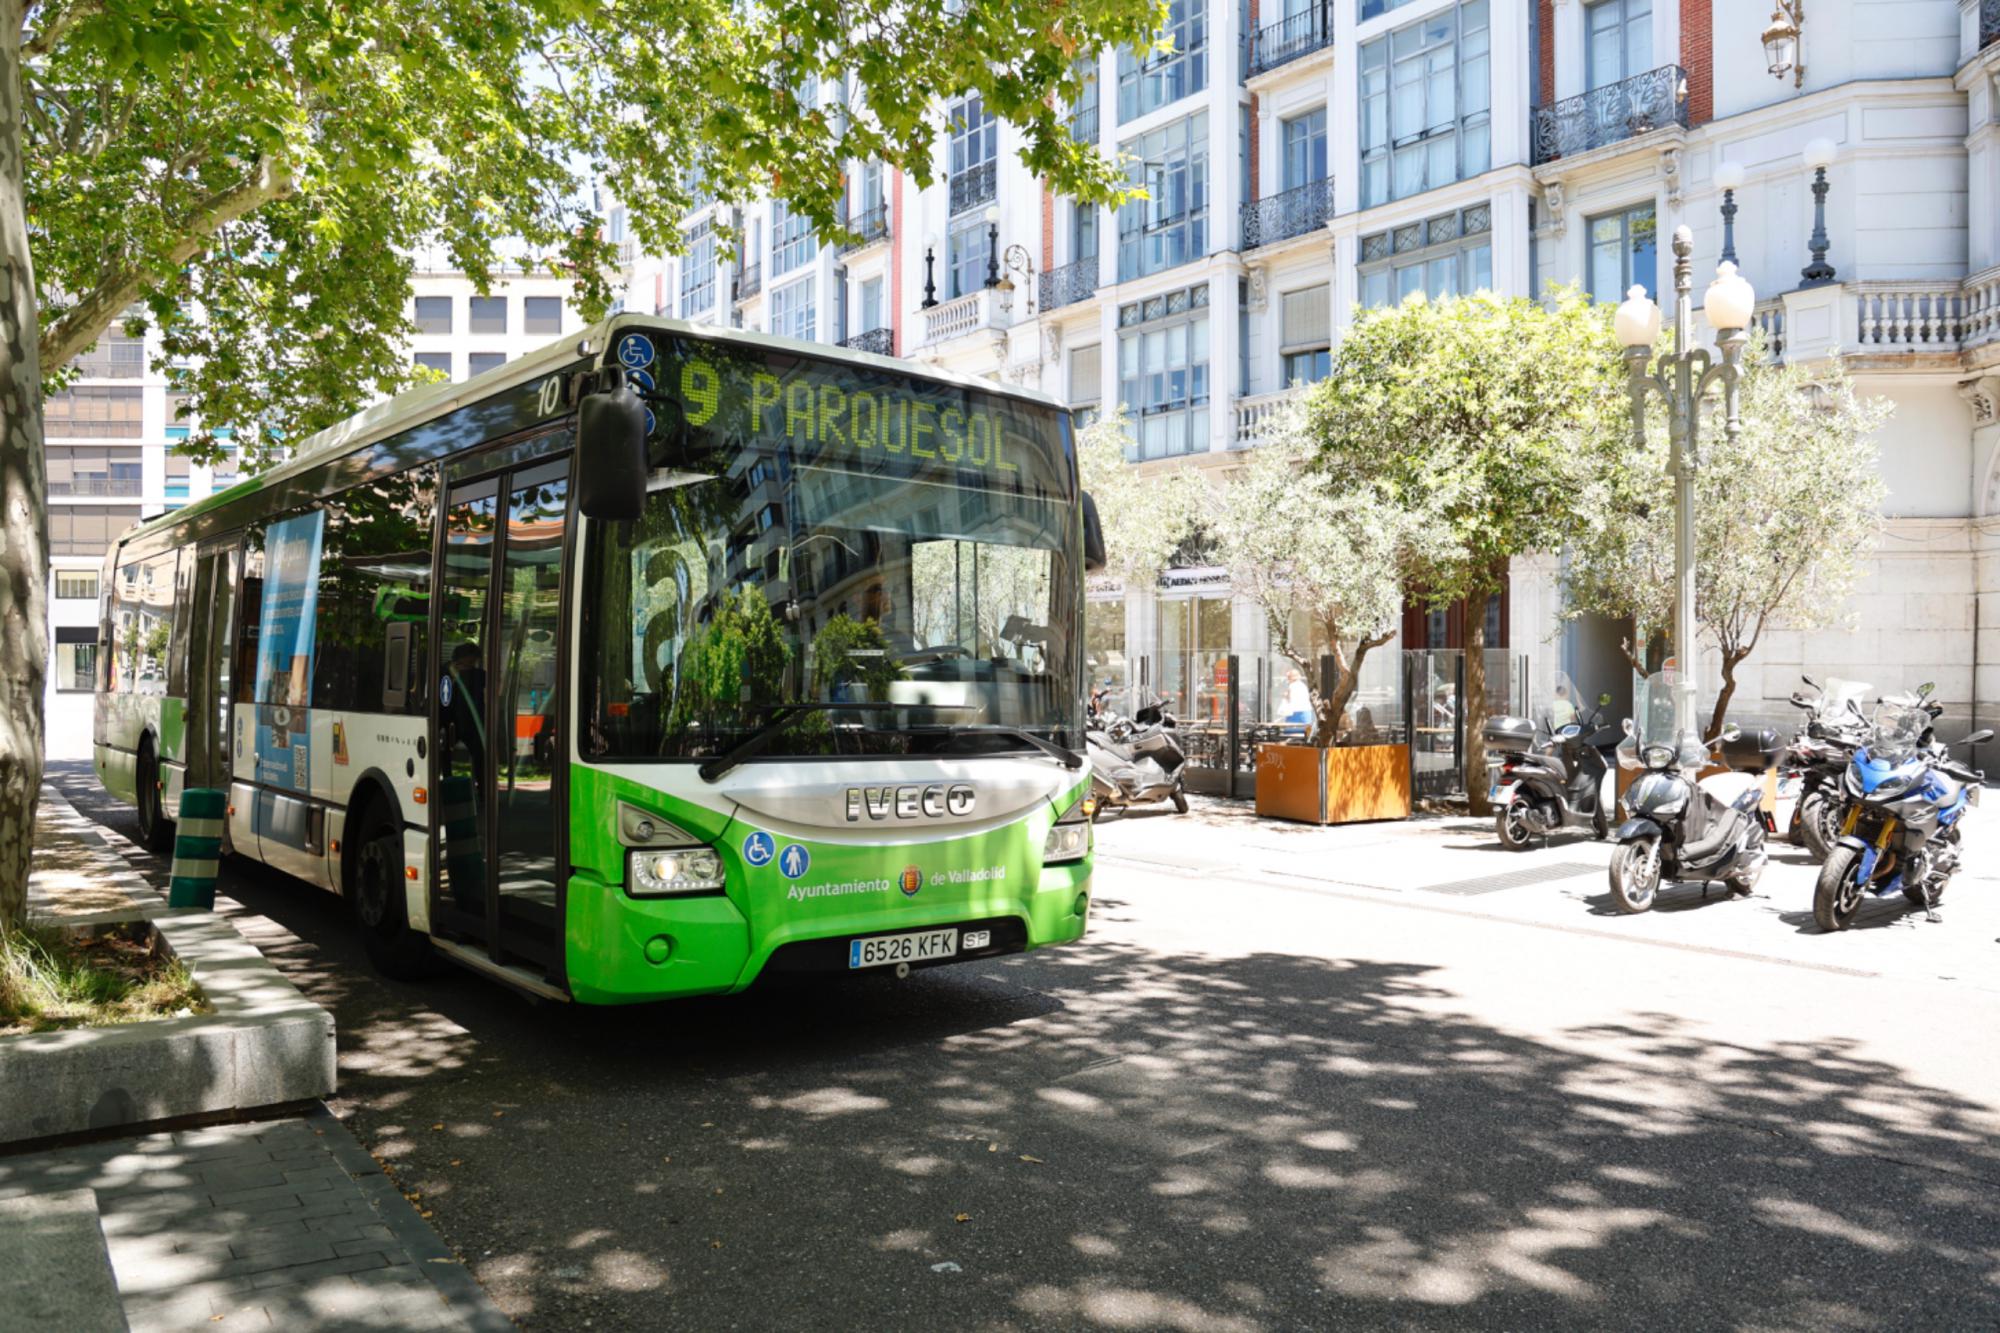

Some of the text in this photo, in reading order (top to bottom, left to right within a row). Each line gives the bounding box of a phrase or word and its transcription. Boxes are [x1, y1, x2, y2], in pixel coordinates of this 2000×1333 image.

[537, 375, 560, 418] 10
[680, 359, 1018, 472] 9 PARQUESOL
[845, 783, 976, 822] IVECO
[787, 865, 1005, 902] Ayuntamiento de Valladolid
[864, 932, 953, 963] 6526 KFK
[965, 932, 988, 948] SP
